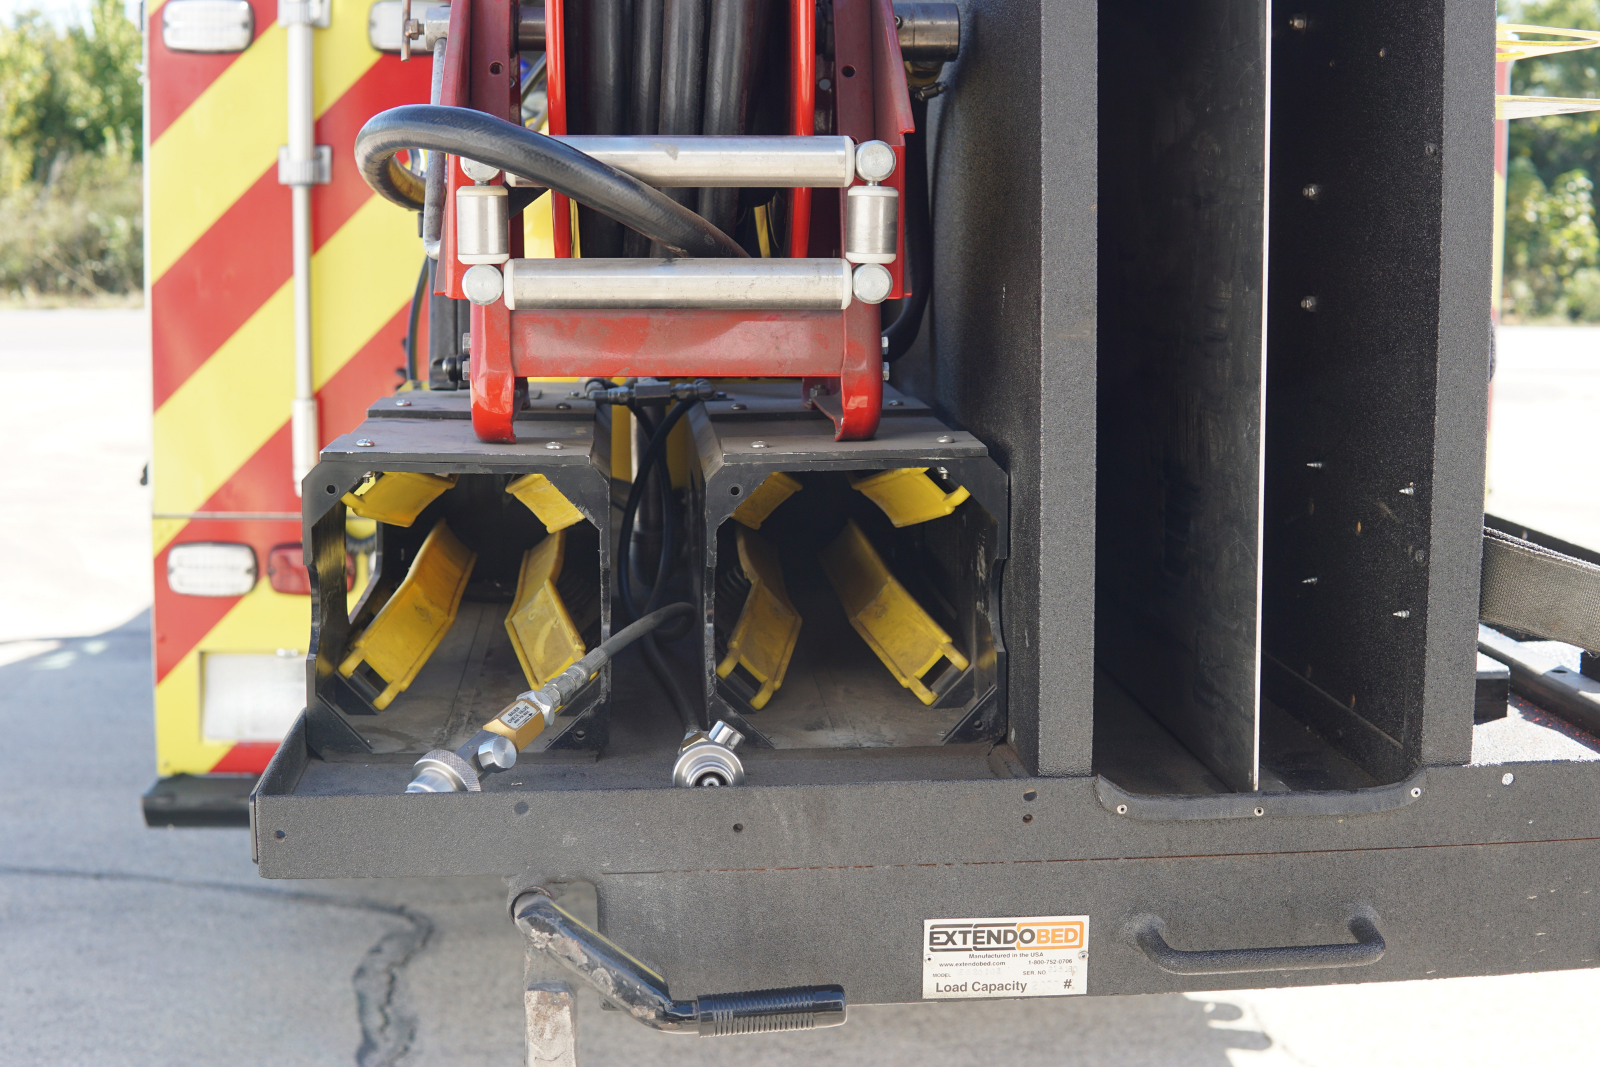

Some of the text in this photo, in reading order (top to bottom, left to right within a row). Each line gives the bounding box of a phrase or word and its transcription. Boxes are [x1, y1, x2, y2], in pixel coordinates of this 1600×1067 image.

[929, 928, 1078, 946] EXTENDOBED
[936, 982, 967, 993] Load
[972, 981, 1027, 994] Capacity
[1064, 979, 1072, 989] #
